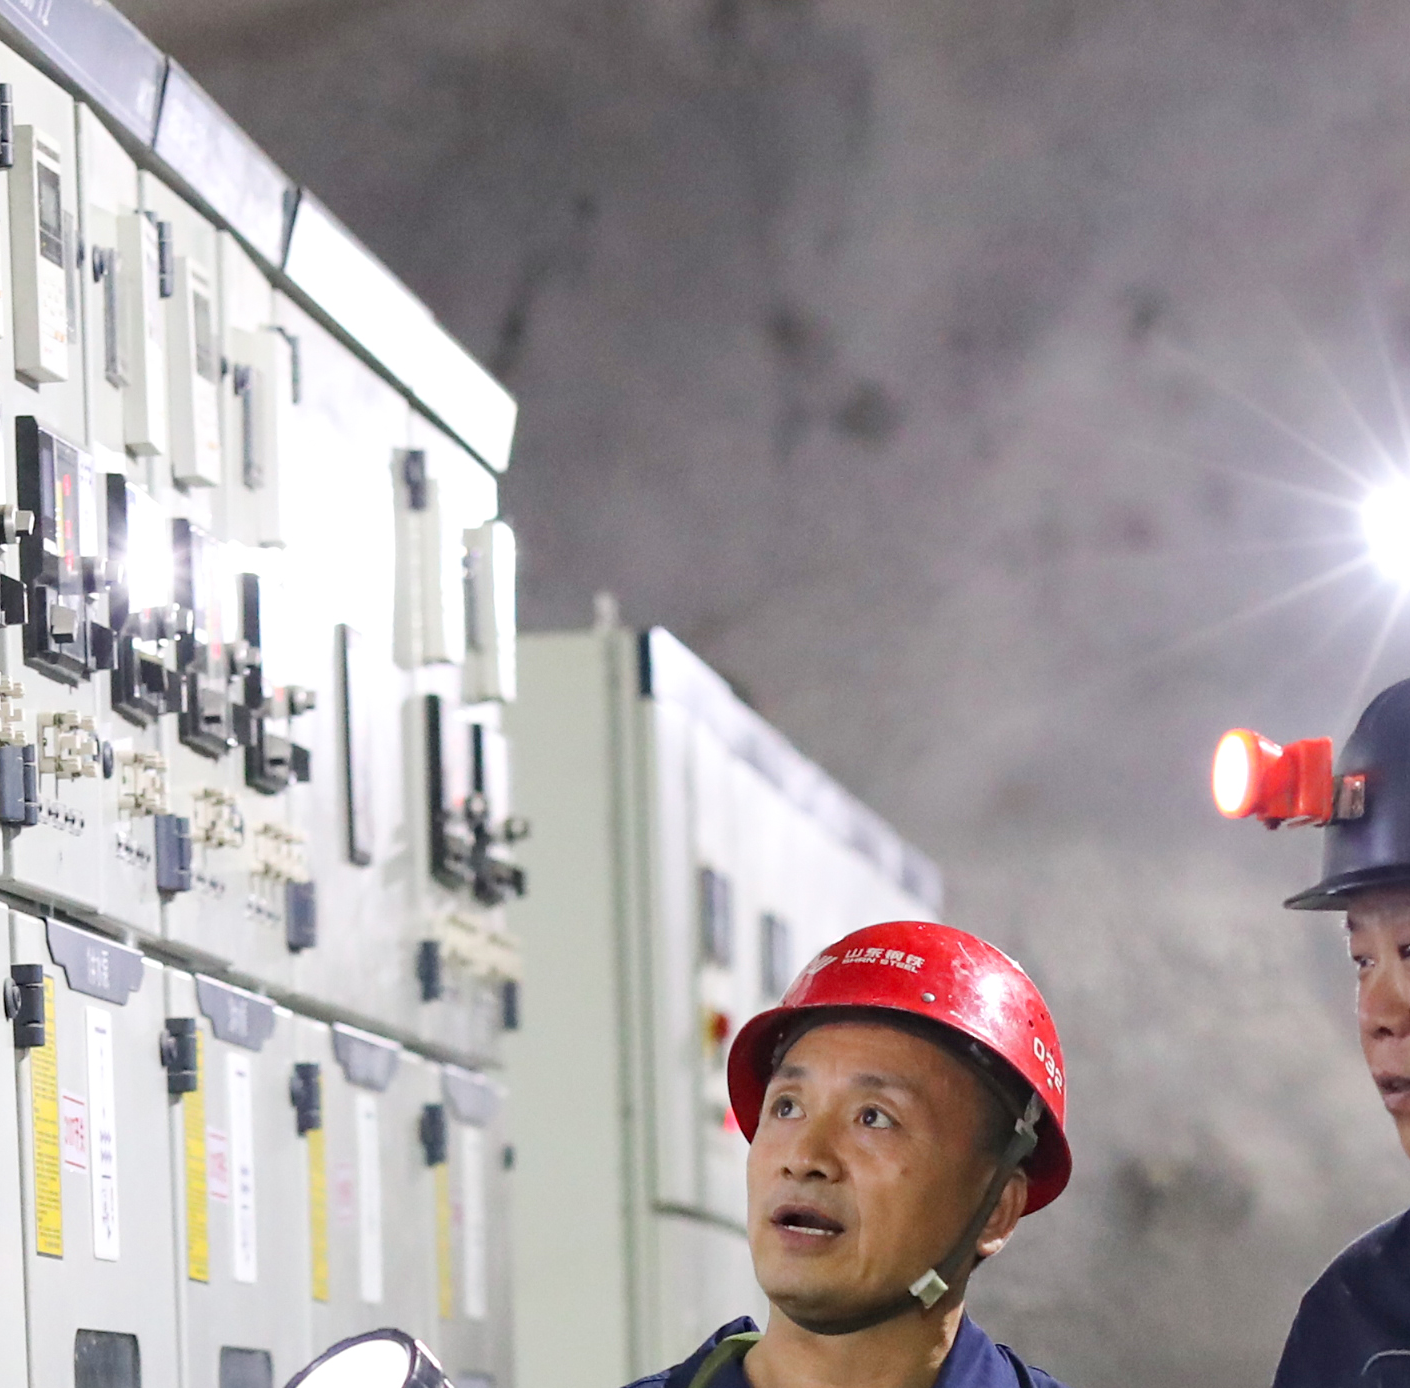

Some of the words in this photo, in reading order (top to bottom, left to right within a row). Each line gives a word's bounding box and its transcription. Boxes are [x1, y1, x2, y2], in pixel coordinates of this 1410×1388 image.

[844, 947, 925, 968] 山东钢铁
[880, 958, 918, 973] STEEL
